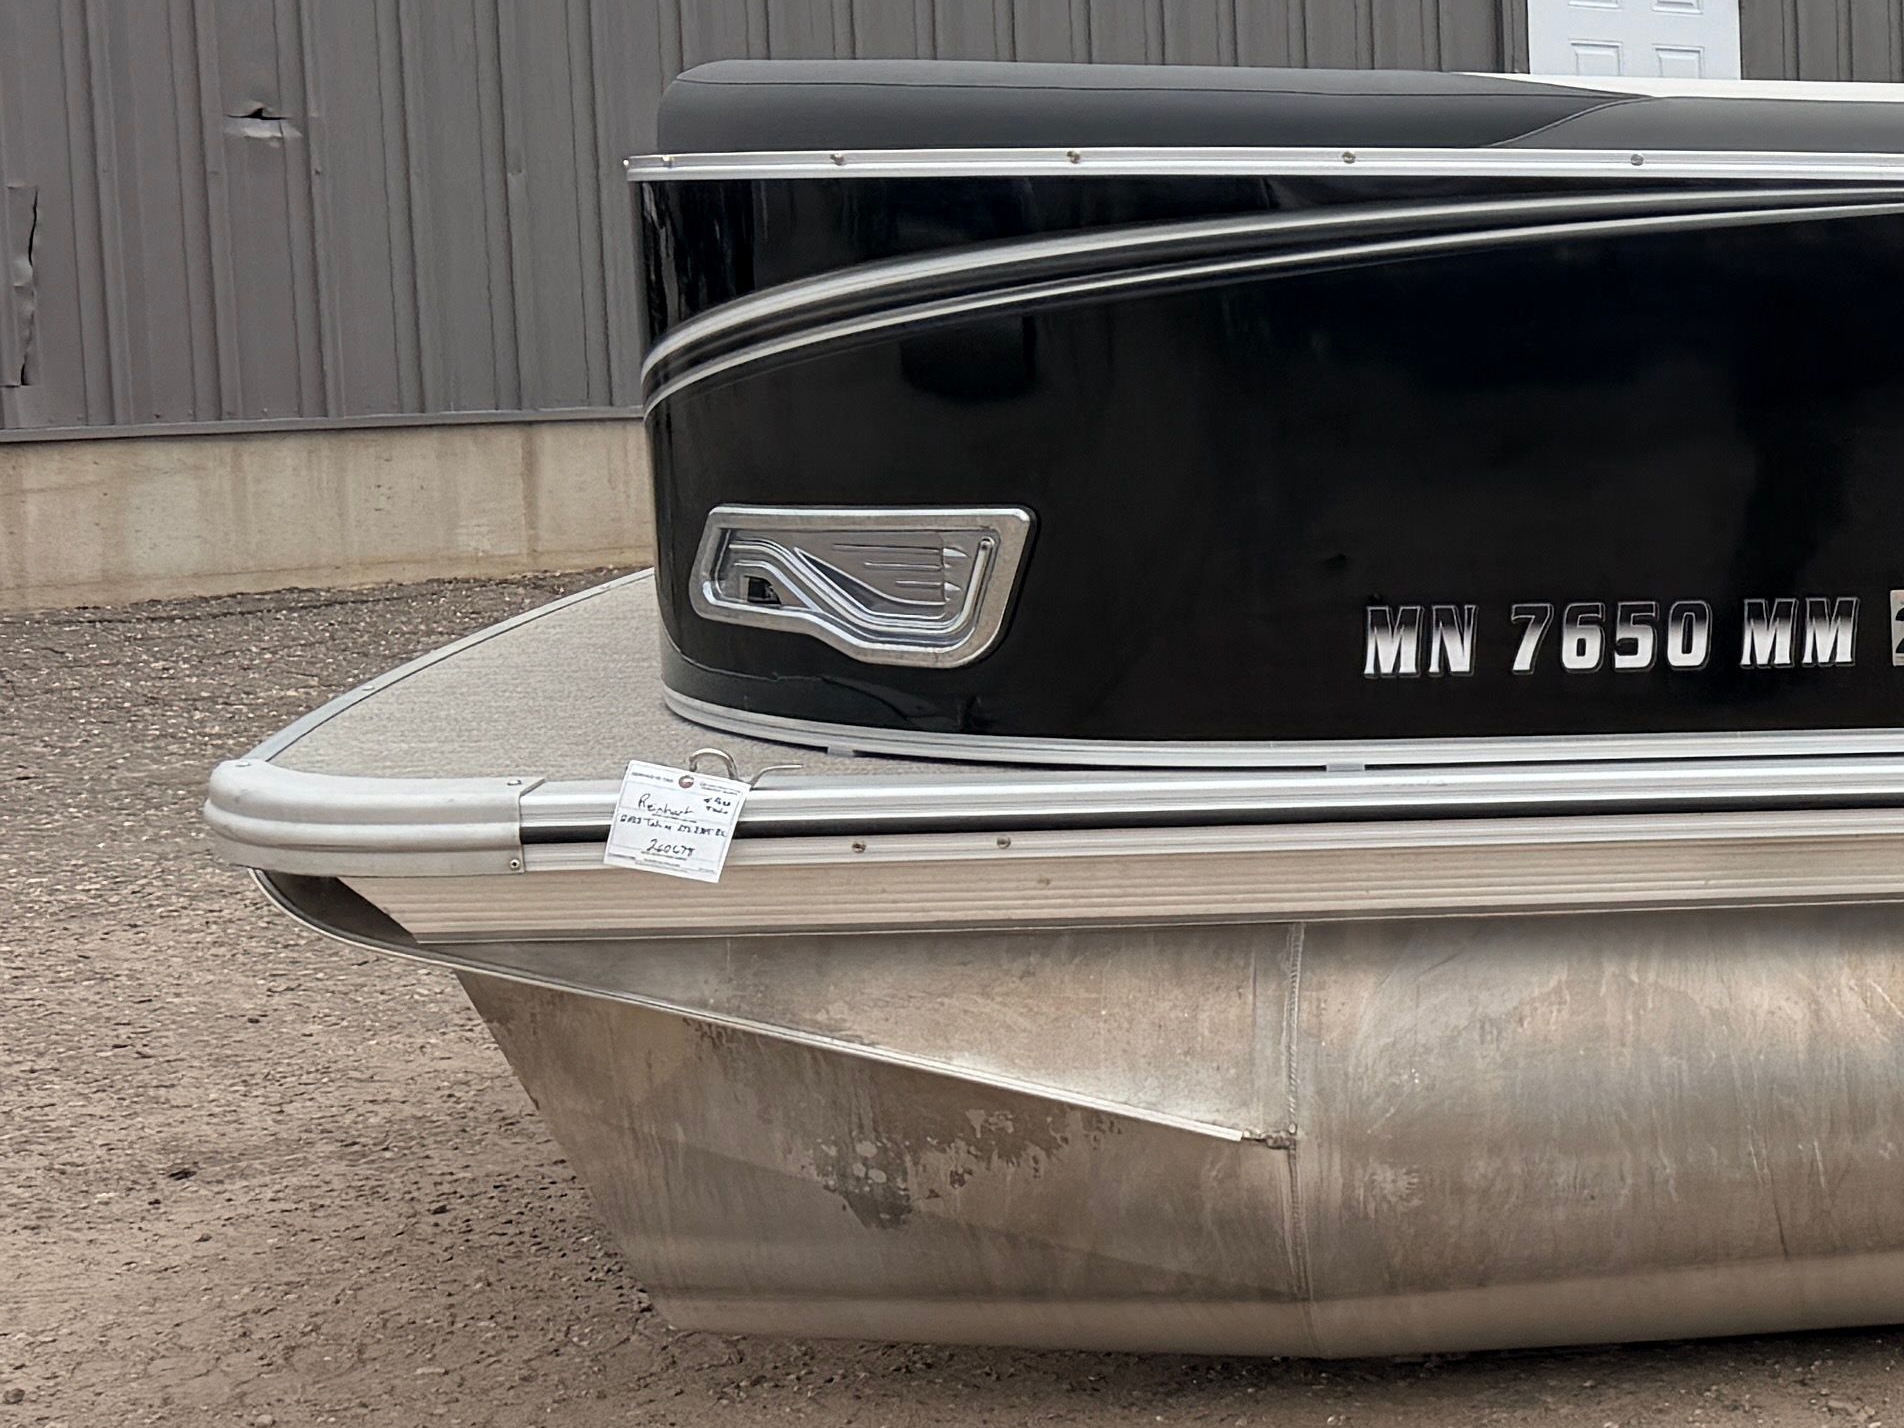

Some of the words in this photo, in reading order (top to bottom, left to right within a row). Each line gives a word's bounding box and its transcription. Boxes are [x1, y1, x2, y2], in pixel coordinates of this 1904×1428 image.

[1363, 604, 1479, 679] MN
[1510, 600, 1713, 674] 7650
[1739, 596, 1861, 669] MM
